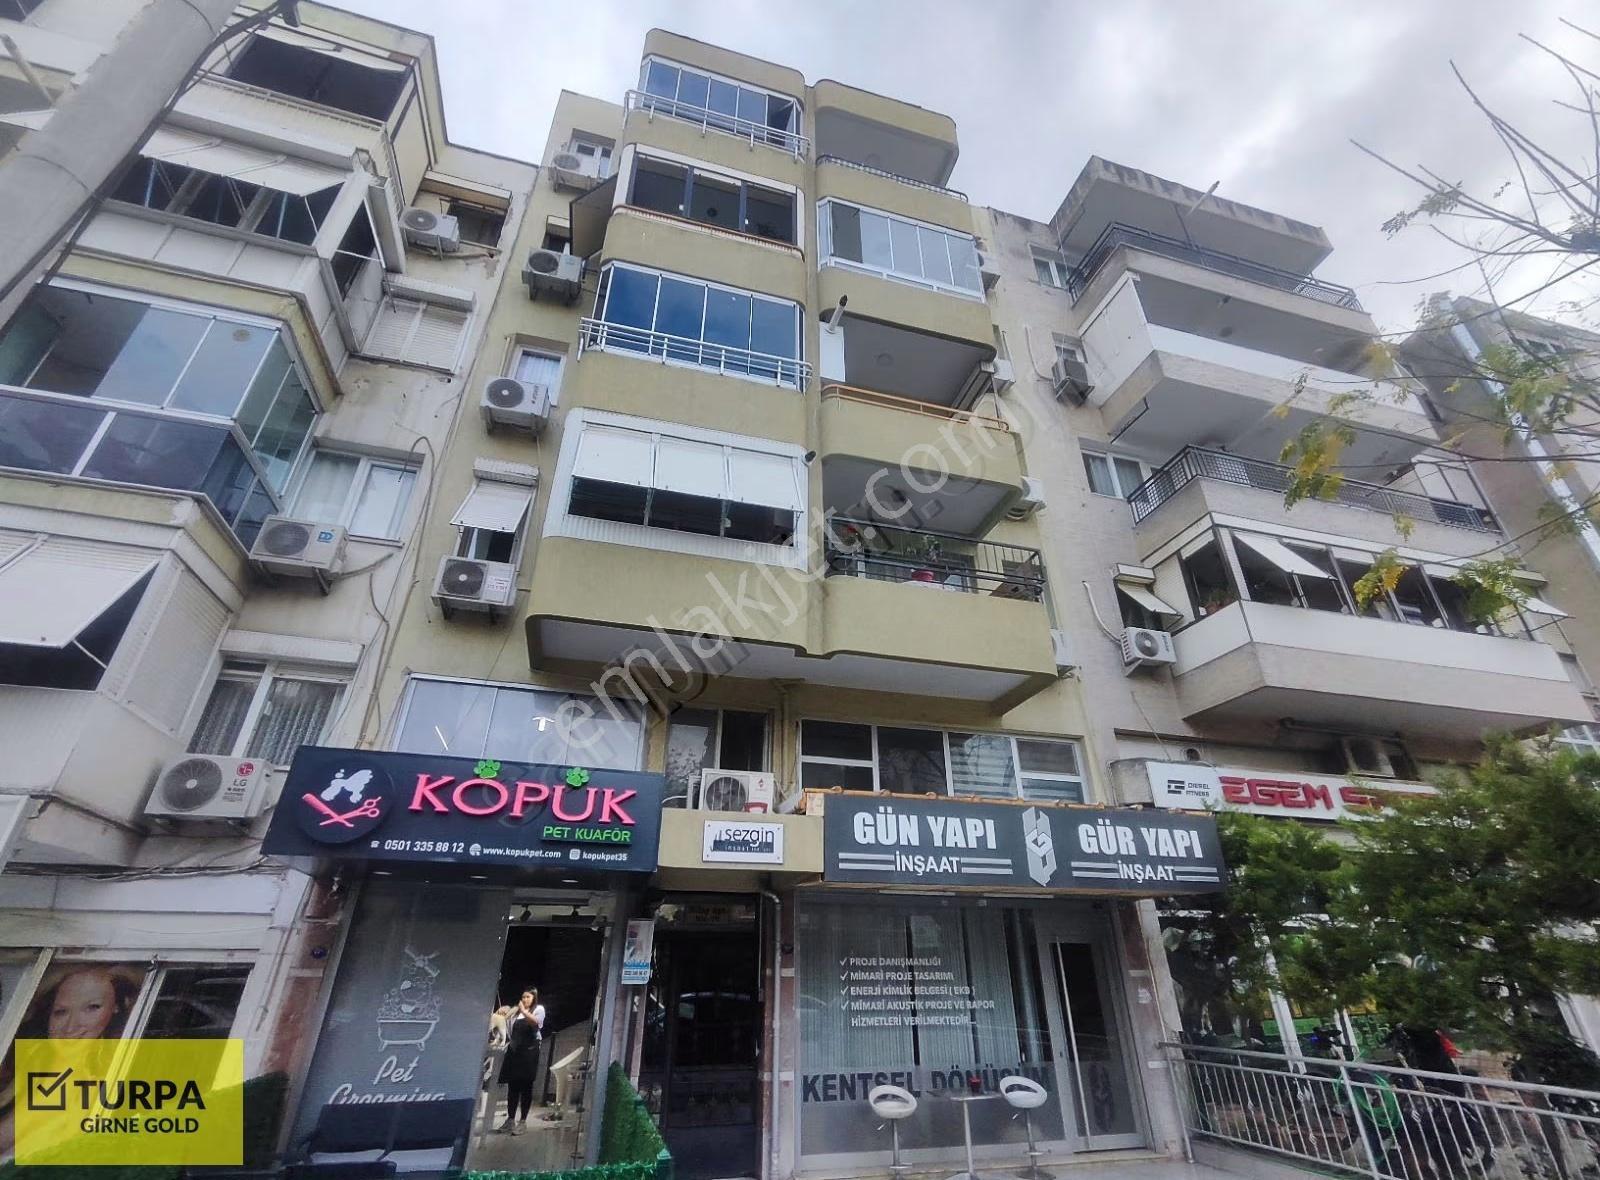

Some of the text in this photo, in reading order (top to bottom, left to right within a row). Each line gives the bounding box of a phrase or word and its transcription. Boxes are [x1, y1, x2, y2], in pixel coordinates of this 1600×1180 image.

[543, 826, 571, 838] PET
[853, 806, 997, 850] GÜN YAPI
[724, 827, 775, 848] sezgin
[1078, 818, 1204, 859] GÜR YAPI
[384, 839, 464, 853] 0501 335 88 12
[483, 847, 561, 858] www.kopukpet.com
[582, 851, 628, 861] kopukpet35
[896, 850, 960, 876] İNŞAAT
[1117, 860, 1175, 883] İNŞAAT
[849, 957, 878, 967] PROJE
[850, 970, 884, 981] MİMARİ
[885, 971, 913, 981] PROJE
[850, 984, 881, 996] ENERJİ
[882, 984, 912, 996] KİMLİK
[914, 984, 948, 996] BELGESİ
[851, 999, 995, 1011] MİMARİ AKUSTİK PROJE VE RAPOR
[851, 1014, 901, 1027] HİZMETLERİ
[373, 1055, 420, 1085] Pet
